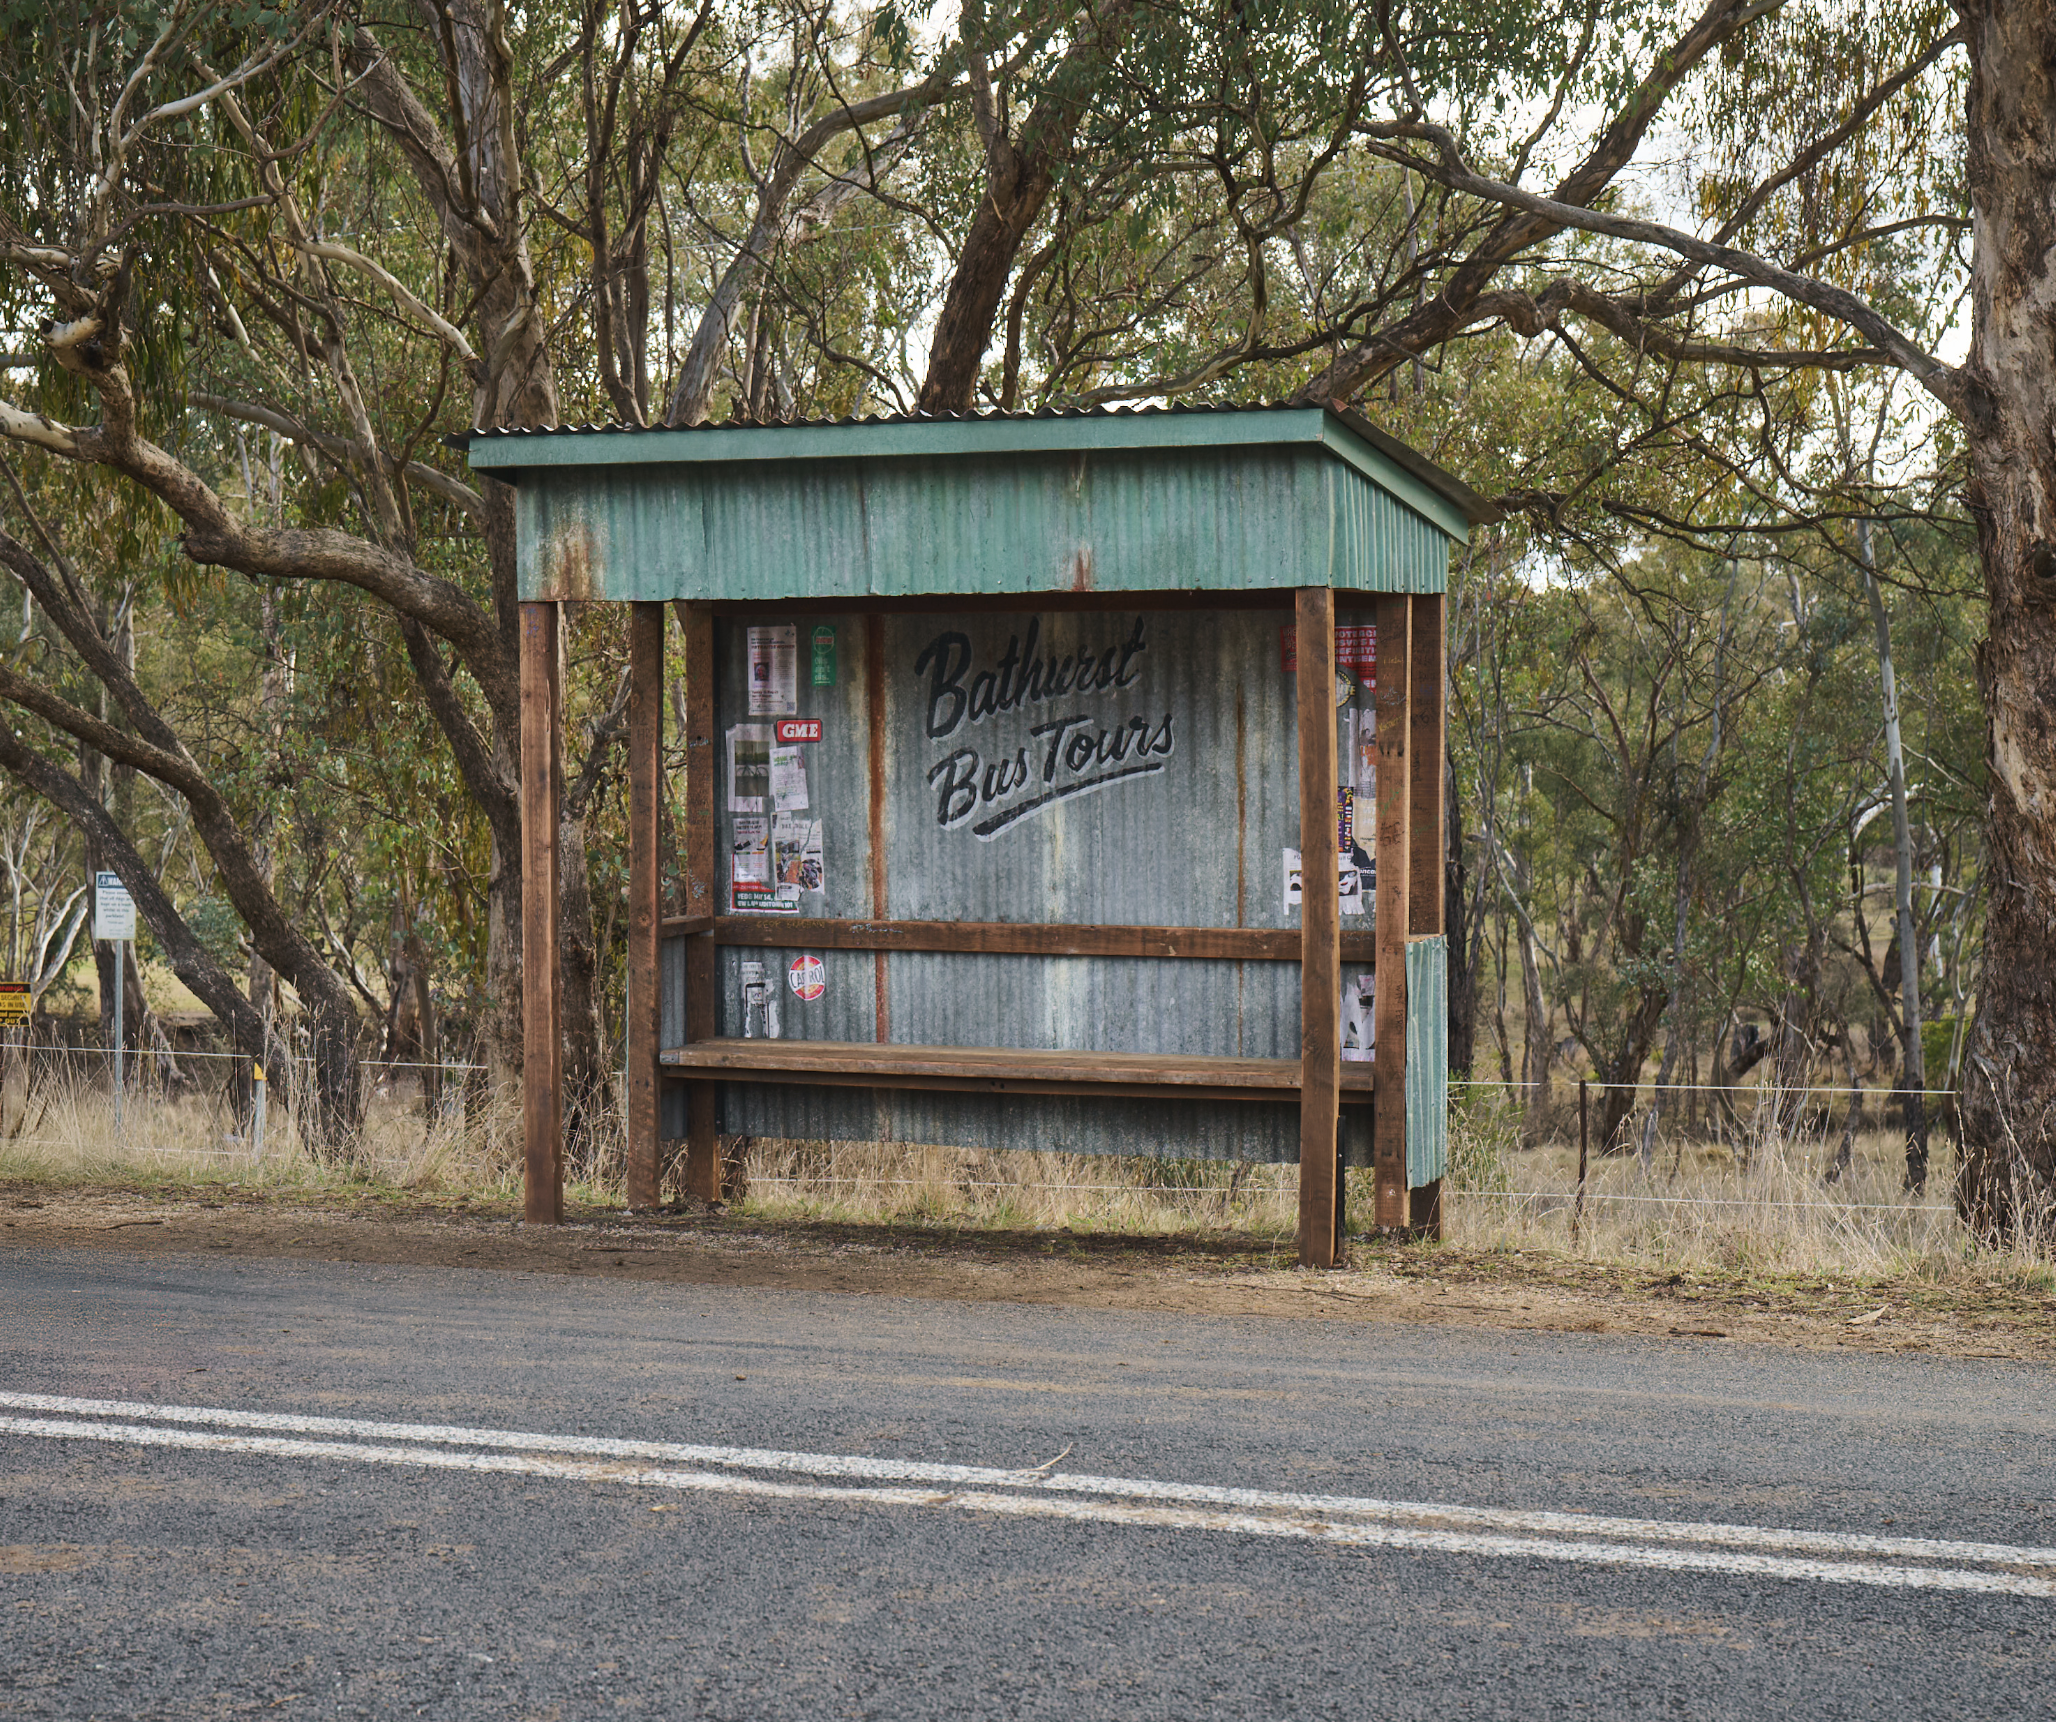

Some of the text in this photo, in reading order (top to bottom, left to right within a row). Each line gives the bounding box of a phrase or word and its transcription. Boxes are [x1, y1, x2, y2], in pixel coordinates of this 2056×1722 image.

[914, 615, 1146, 745] Bathurst
[782, 723, 818, 738] GME
[926, 713, 1175, 831] Bus Tours
[790, 965, 825, 989] CASROL
